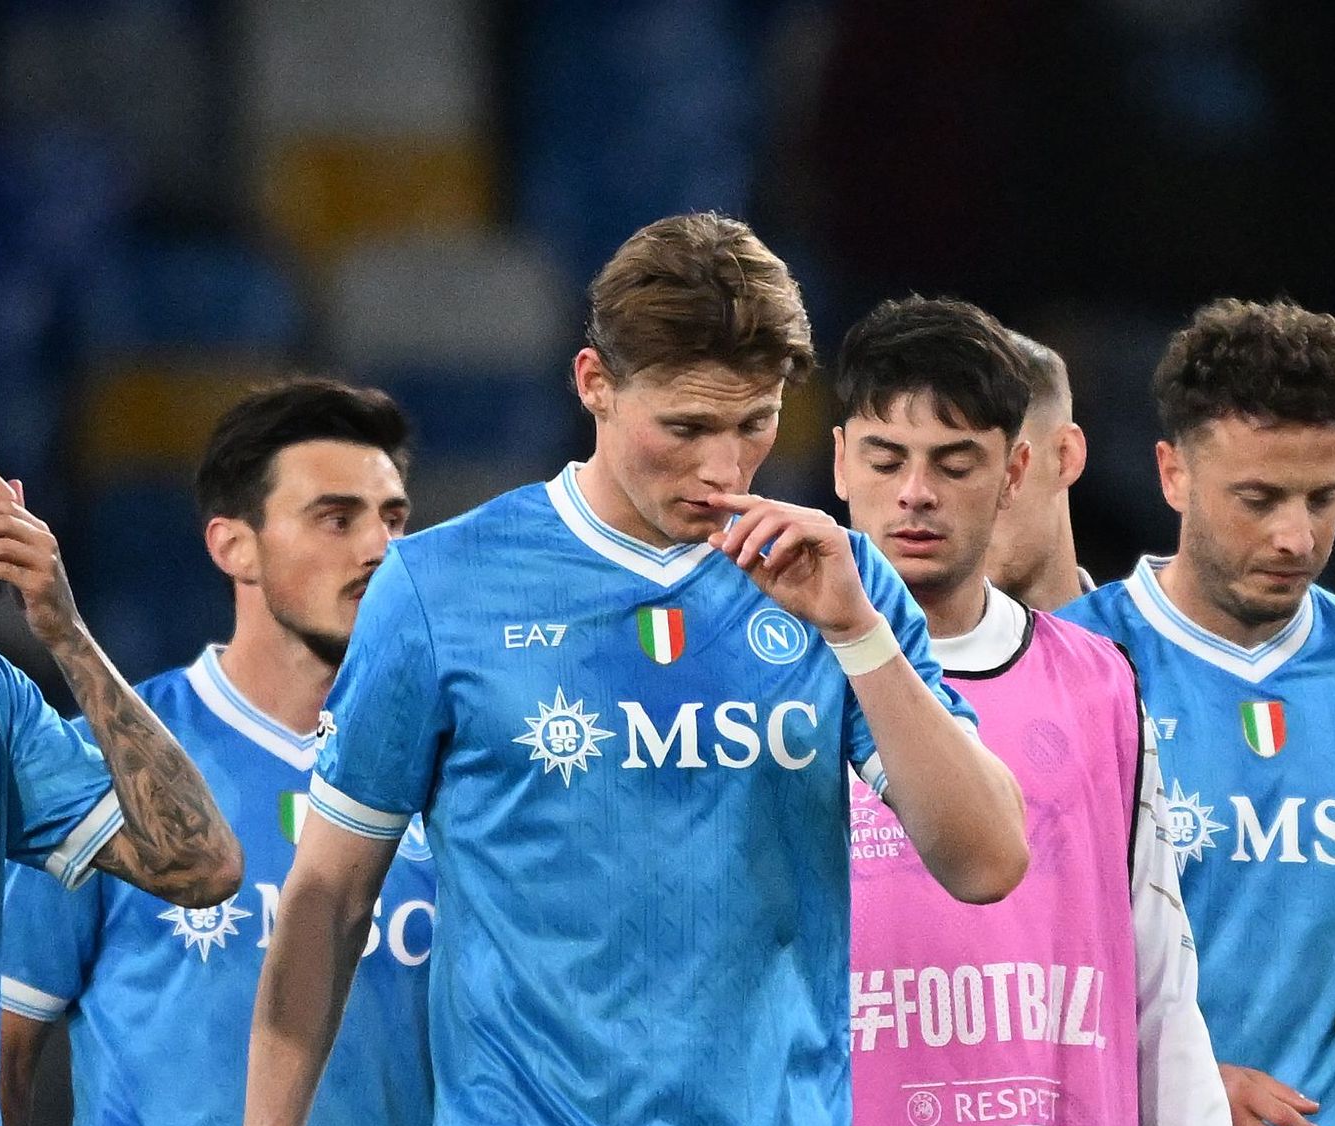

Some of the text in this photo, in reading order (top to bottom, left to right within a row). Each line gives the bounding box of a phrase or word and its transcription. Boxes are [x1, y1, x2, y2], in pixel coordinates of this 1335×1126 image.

[504, 623, 568, 649] EA7
[763, 623, 792, 650] N
[618, 701, 817, 770] MSC
